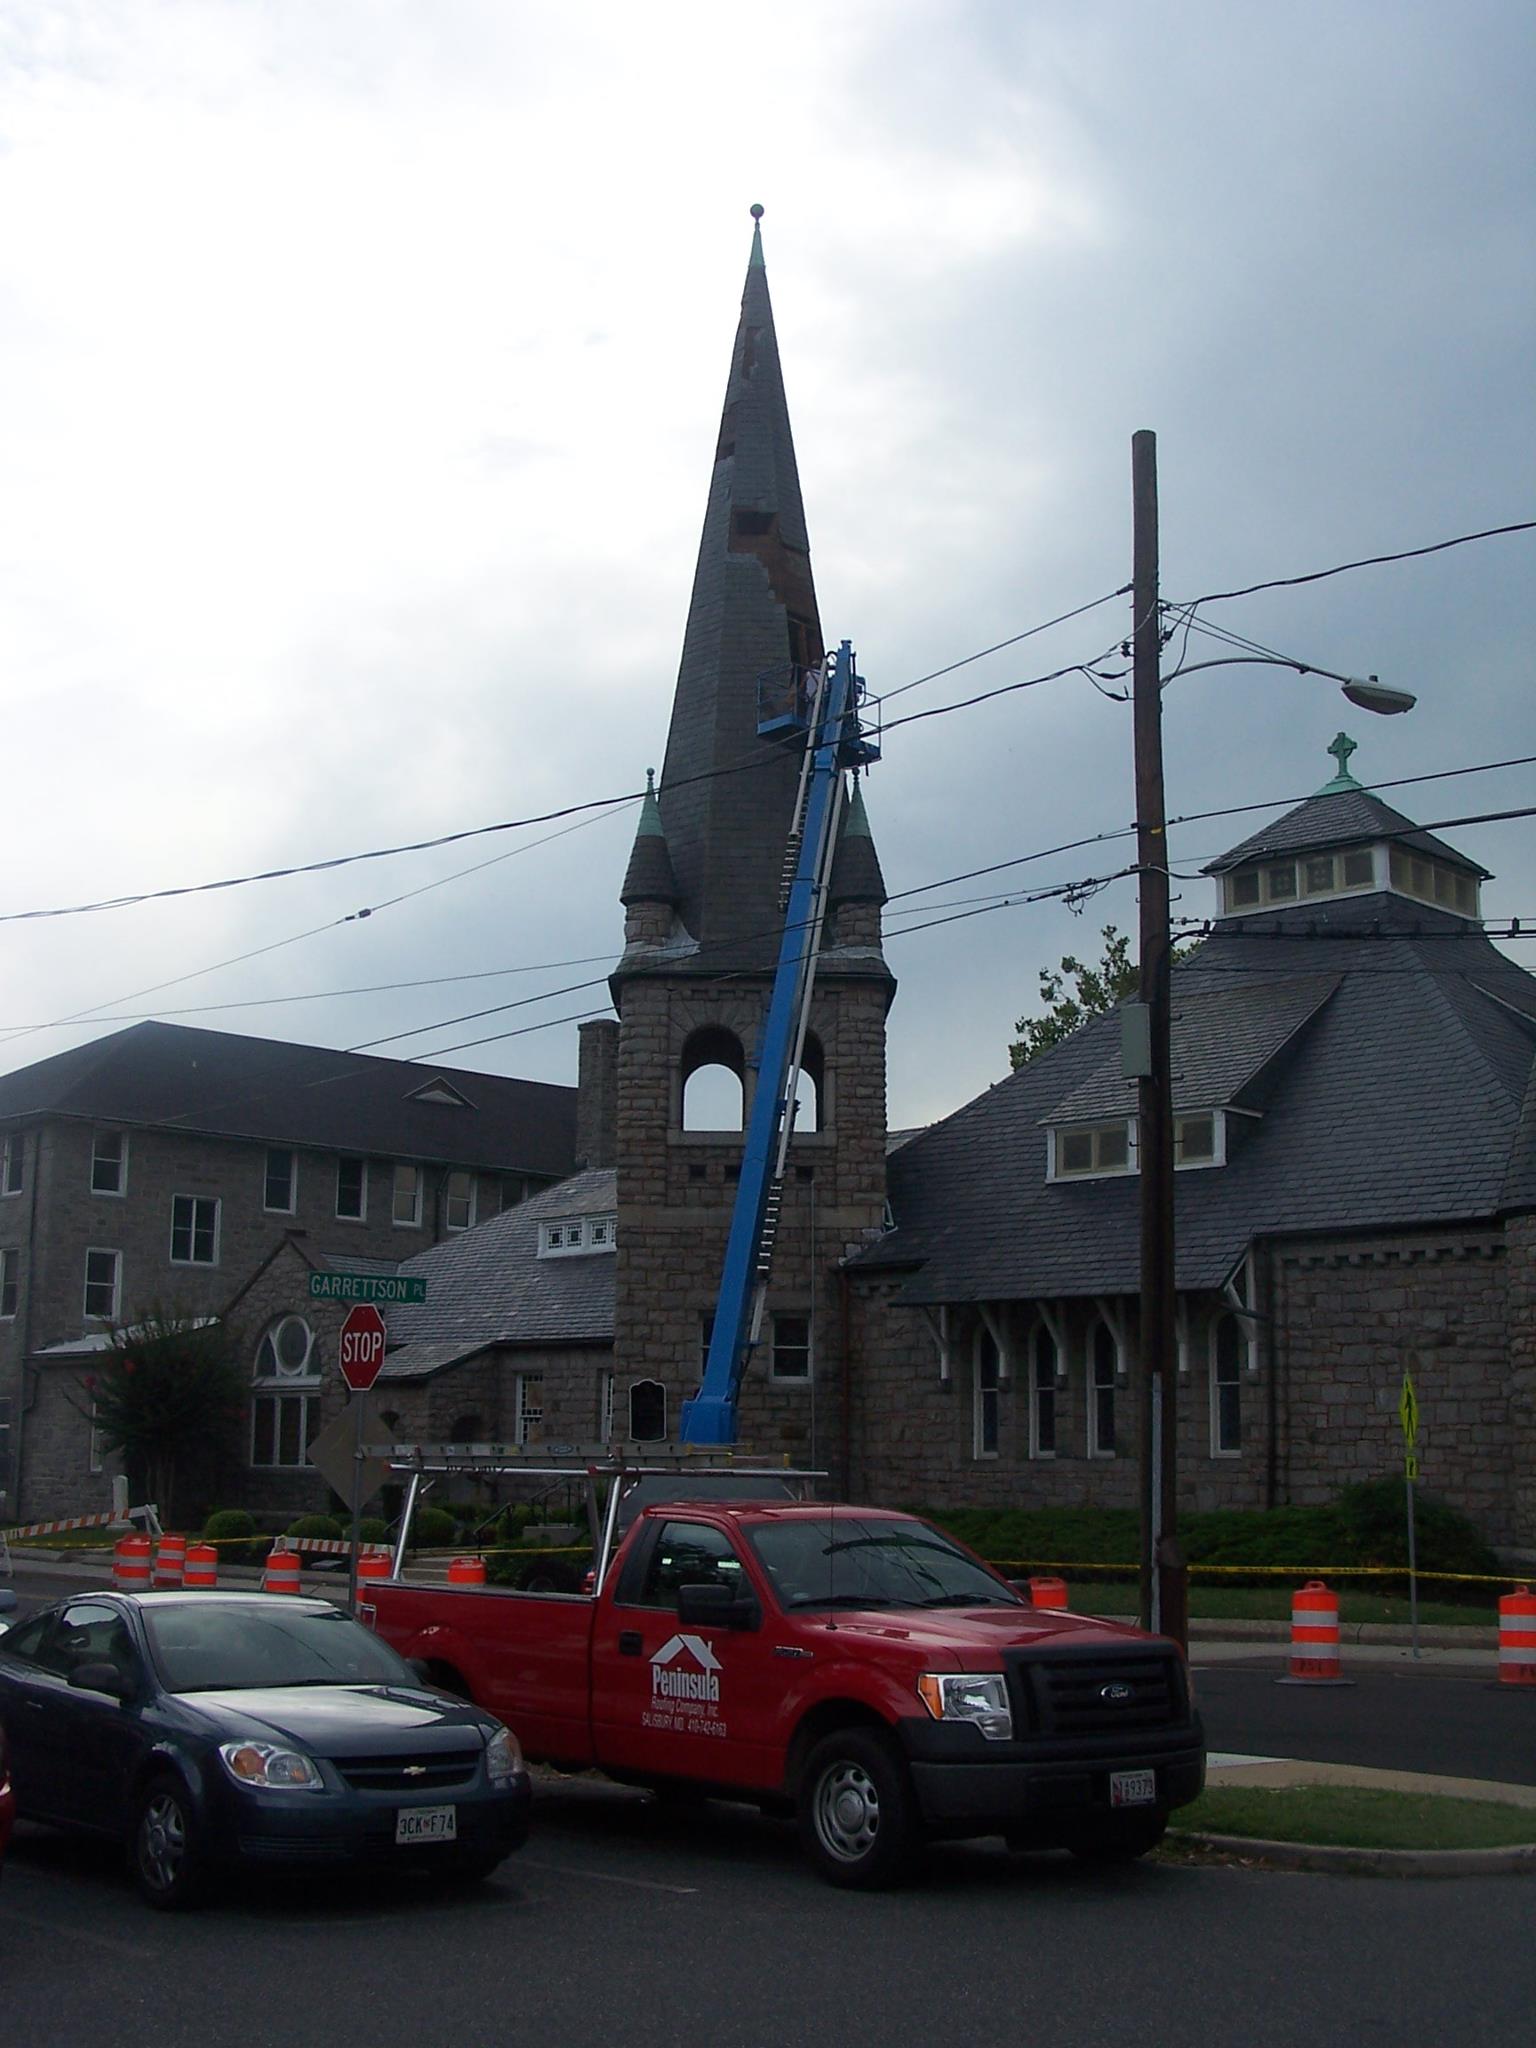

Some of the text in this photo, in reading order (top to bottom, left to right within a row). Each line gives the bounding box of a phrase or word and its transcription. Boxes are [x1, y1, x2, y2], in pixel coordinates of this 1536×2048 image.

[311, 1275, 426, 1299] GARRETTSON PL
[343, 1332, 382, 1362] STOP
[652, 1665, 720, 1701] Peninsula
